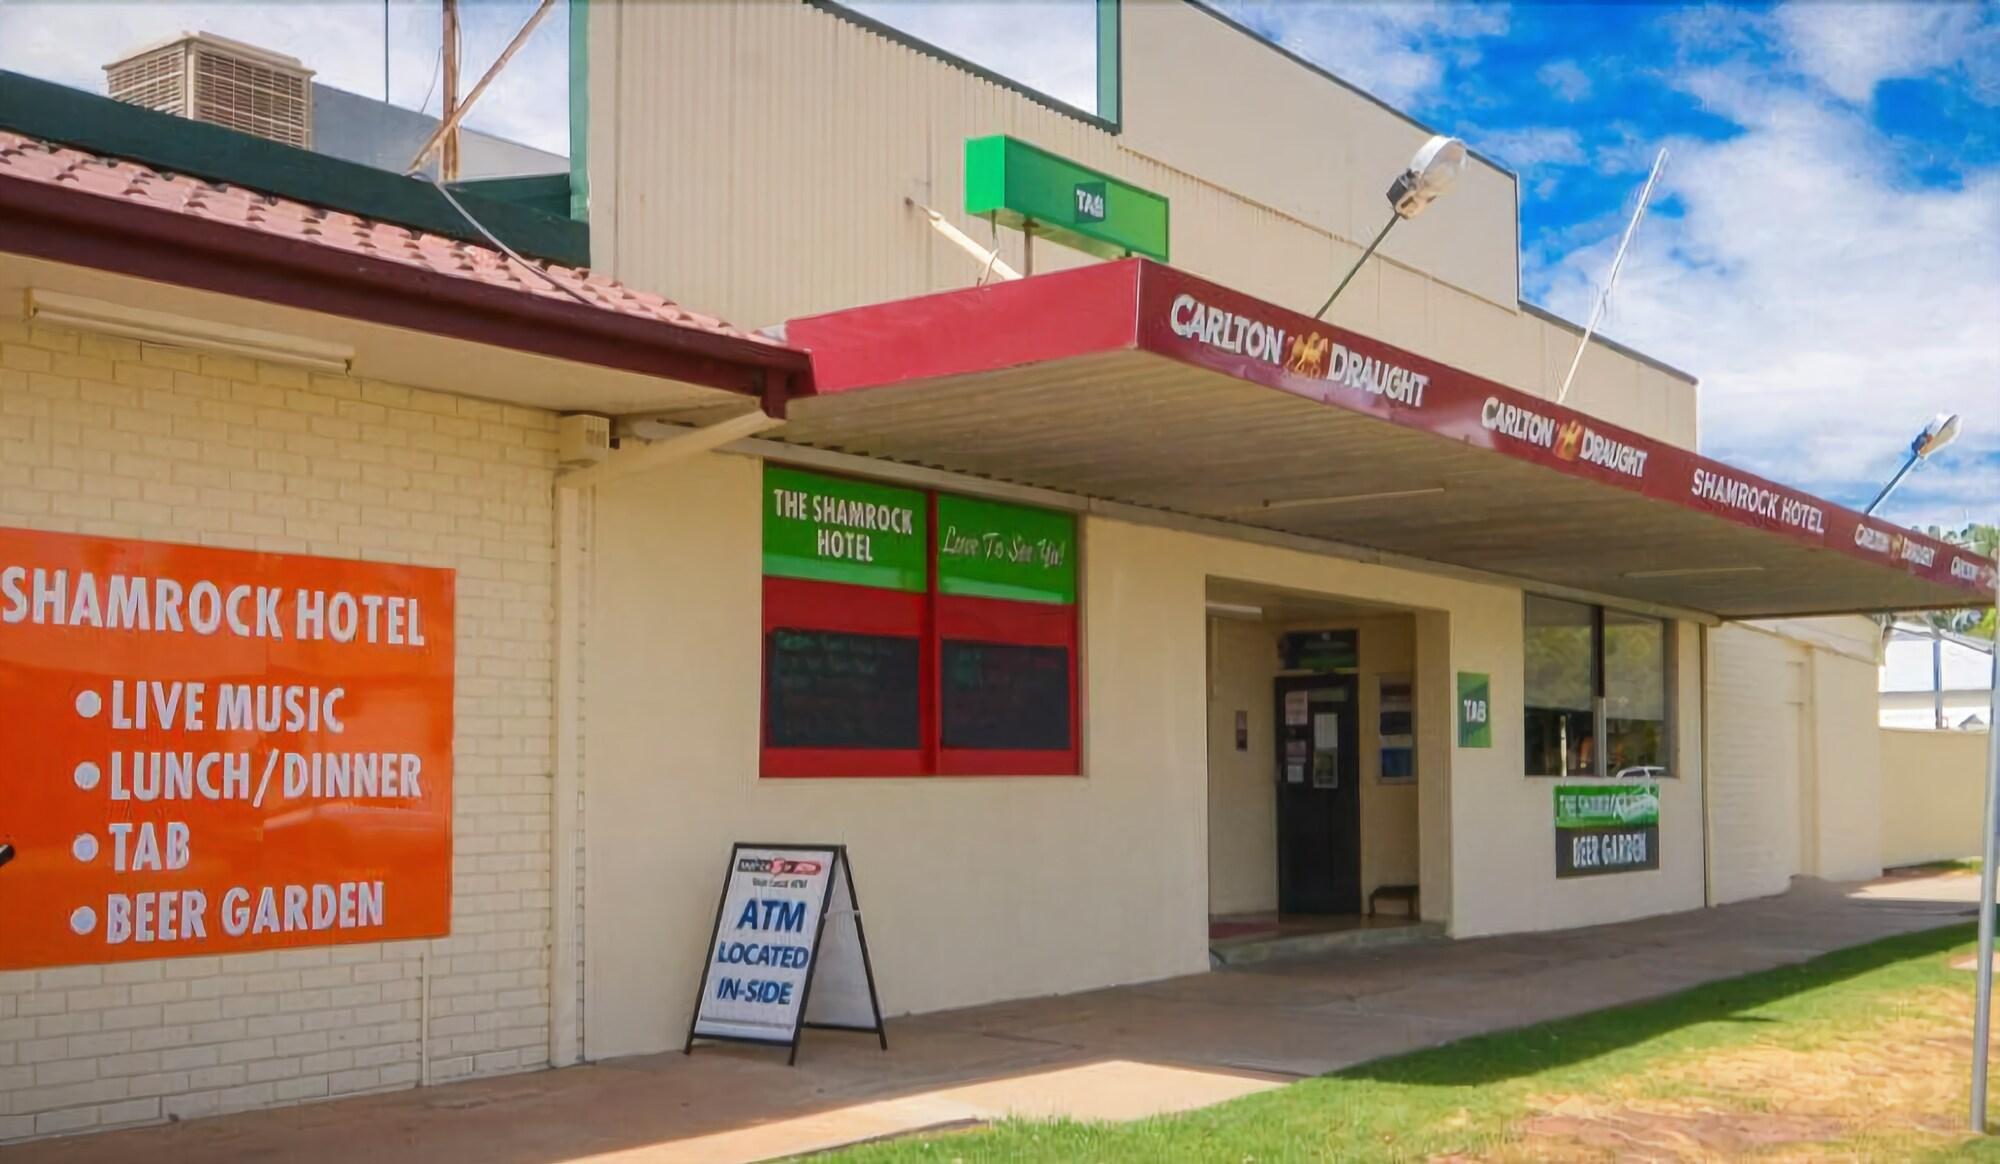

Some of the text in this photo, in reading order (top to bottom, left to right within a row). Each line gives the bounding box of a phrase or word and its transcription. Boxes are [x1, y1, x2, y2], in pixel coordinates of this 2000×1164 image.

[1076, 189, 1104, 218] TAB
[1170, 294, 1431, 407] CARLTON DRAUGHT
[1481, 396, 1647, 478] CARLTON DRAUGHT
[774, 489, 912, 535] THE SHAMROCK
[1691, 468, 1825, 533] SHAMROCK HOTEL
[817, 529, 873, 562] HOTEL
[1, 566, 425, 646] SHAMROCK HOTEL
[112, 680, 345, 734] LIVE MUSIC
[1464, 699, 1487, 723] TAB
[111, 748, 422, 808] LUNCH/DINNER
[108, 822, 190, 871] TAB
[106, 881, 384, 944] BEER GARDEN
[737, 898, 806, 933] ATM
[717, 941, 809, 969] LOCATED
[717, 976, 794, 1005] IN-SIDE
